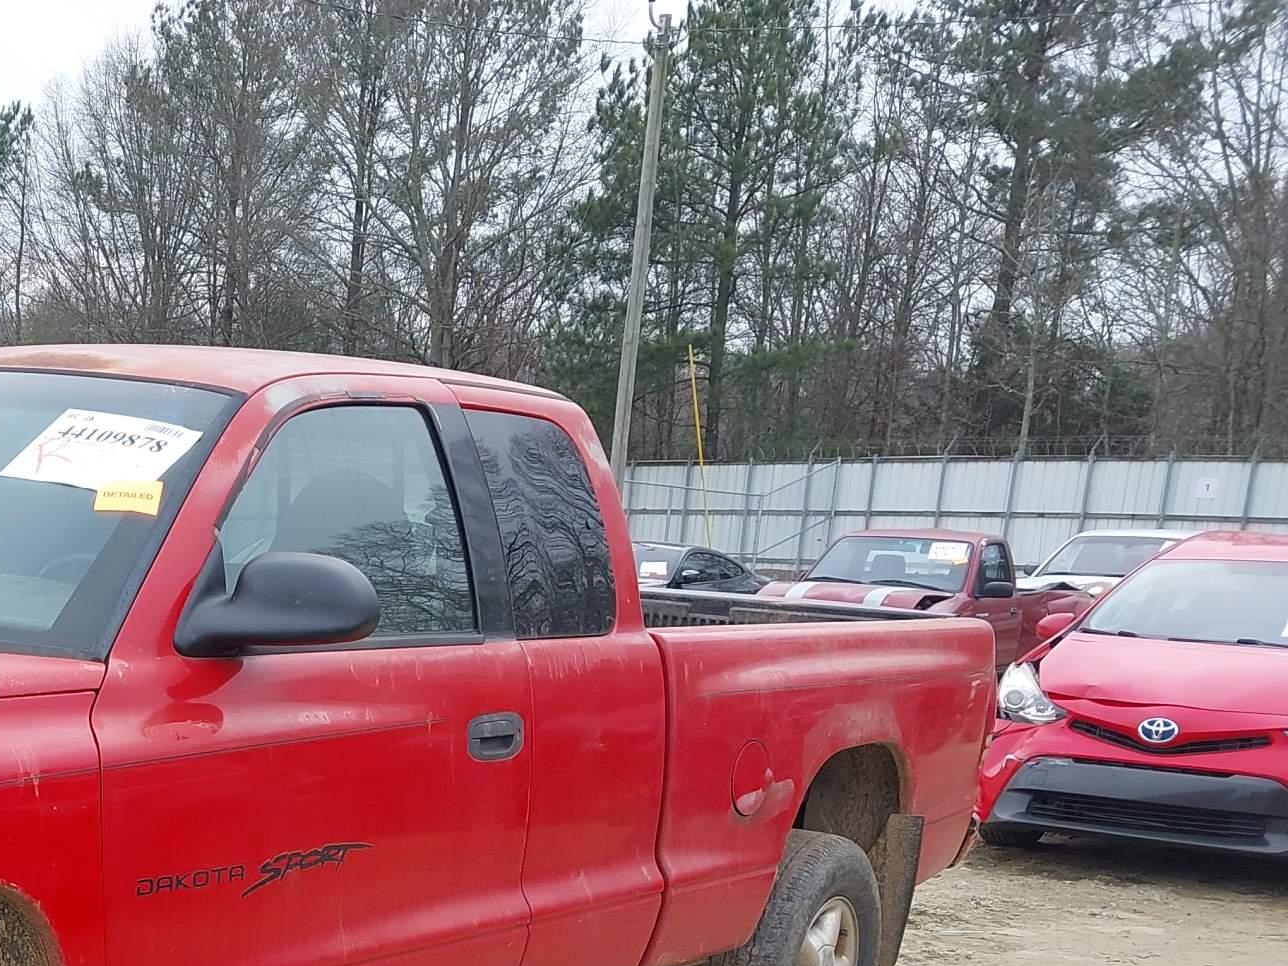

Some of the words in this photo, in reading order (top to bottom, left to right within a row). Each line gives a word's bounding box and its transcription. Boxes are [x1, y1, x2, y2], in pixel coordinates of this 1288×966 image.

[58, 425, 168, 453] 44109878
[102, 490, 154, 501] DETAILED
[135, 864, 246, 897] DAKOTA
[240, 842, 374, 899] SPORT
